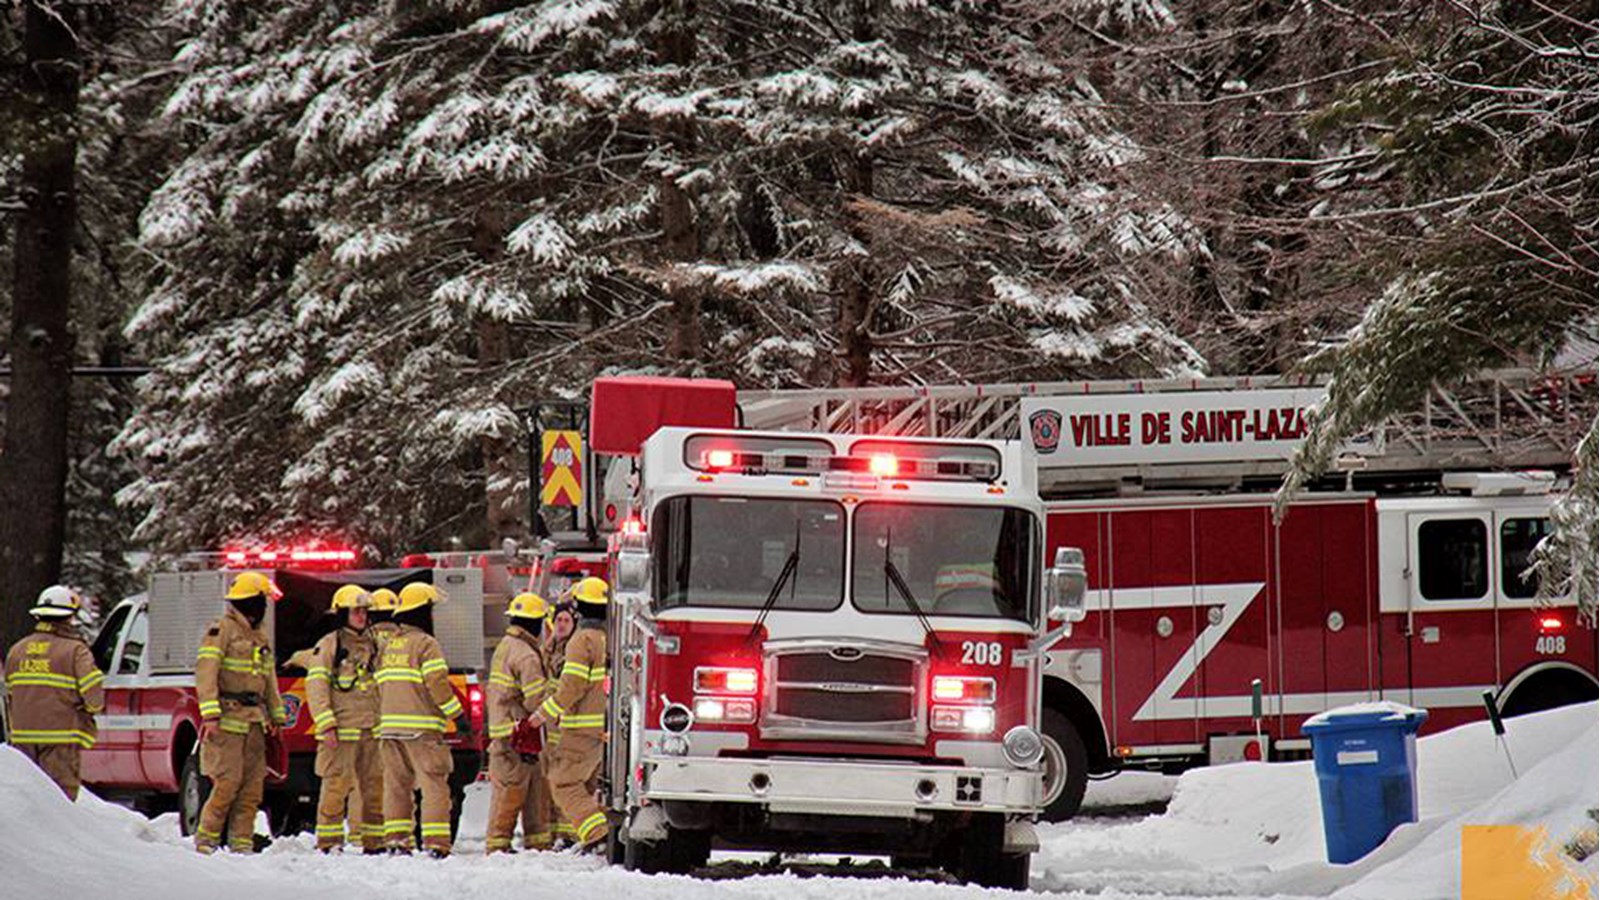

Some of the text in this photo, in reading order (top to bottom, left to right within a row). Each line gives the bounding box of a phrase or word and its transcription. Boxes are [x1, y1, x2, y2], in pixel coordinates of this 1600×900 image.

[1069, 406, 1309, 448] VILLE DE SAINT-LAZA
[961, 640, 1003, 666] 208
[1535, 635, 1566, 655] 408
